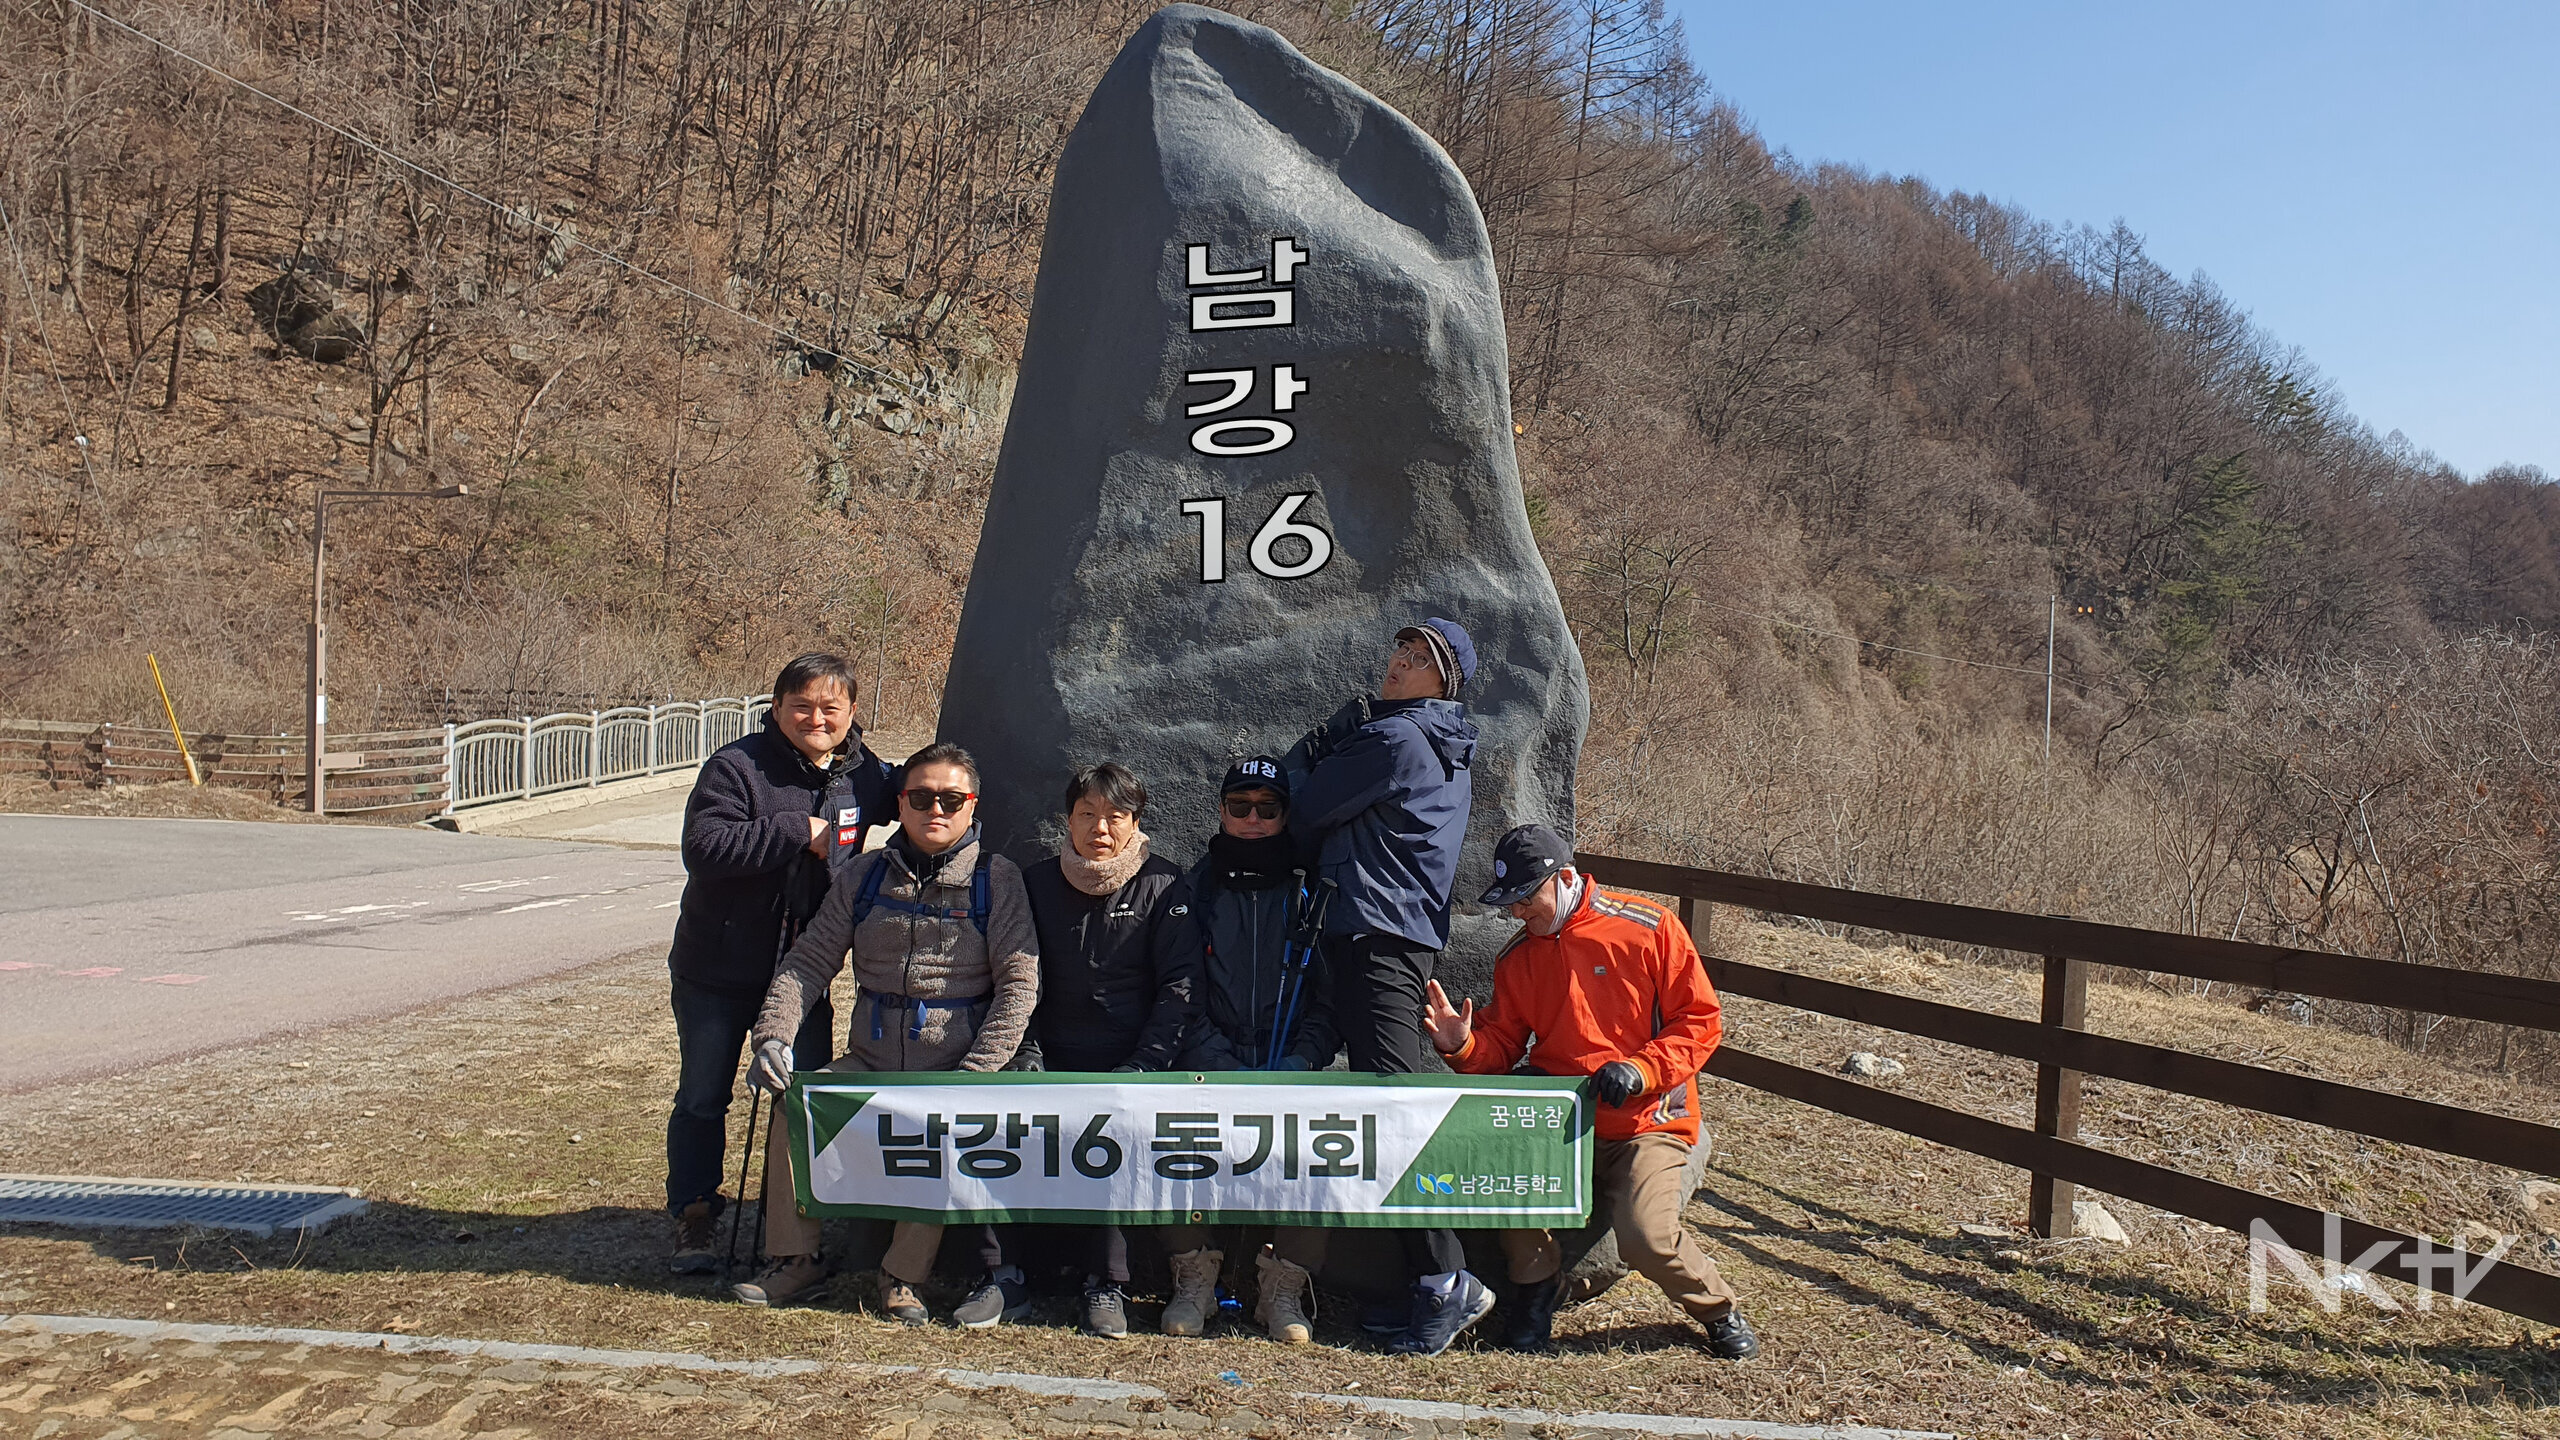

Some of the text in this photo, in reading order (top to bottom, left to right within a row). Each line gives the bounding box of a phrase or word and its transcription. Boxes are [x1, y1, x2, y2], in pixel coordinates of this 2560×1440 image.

[1242, 760, 1277, 778] 대장
[877, 1112, 1377, 1181] 남강16 동기회
[1459, 1173, 1563, 1196] 남강고등학교
